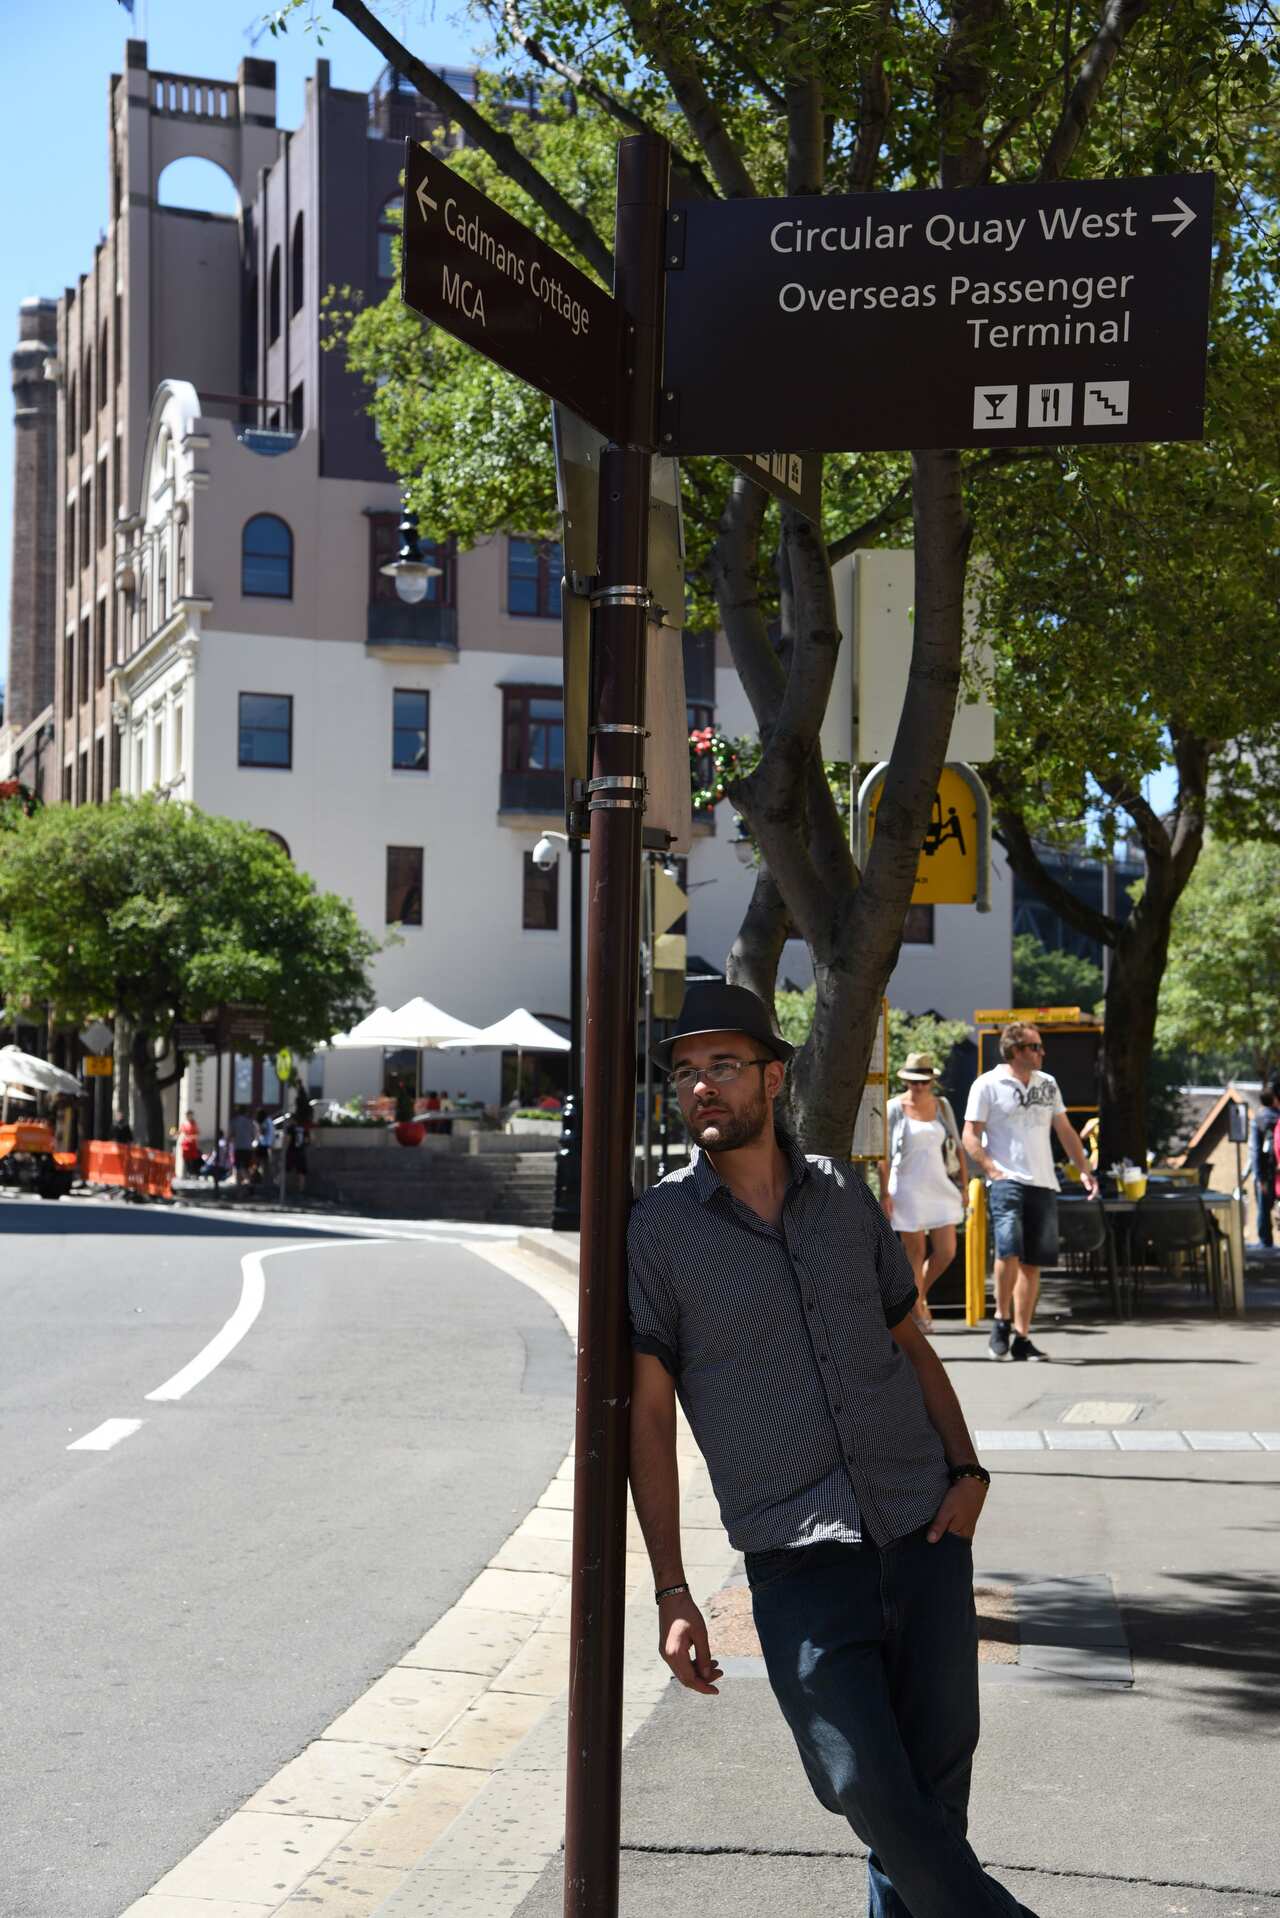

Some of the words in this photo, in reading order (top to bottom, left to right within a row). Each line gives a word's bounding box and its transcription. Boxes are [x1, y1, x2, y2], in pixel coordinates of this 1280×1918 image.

[770, 216, 913, 253] Circular
[925, 214, 1026, 252] Quay
[1038, 206, 1138, 241] West
[444, 198, 526, 285] Cadmans
[529, 261, 589, 335] Cottage
[442, 264, 486, 327] MCA
[778, 282, 936, 313] Overseas
[950, 275, 1135, 309] Passenger
[966, 311, 1130, 349] Terminal
